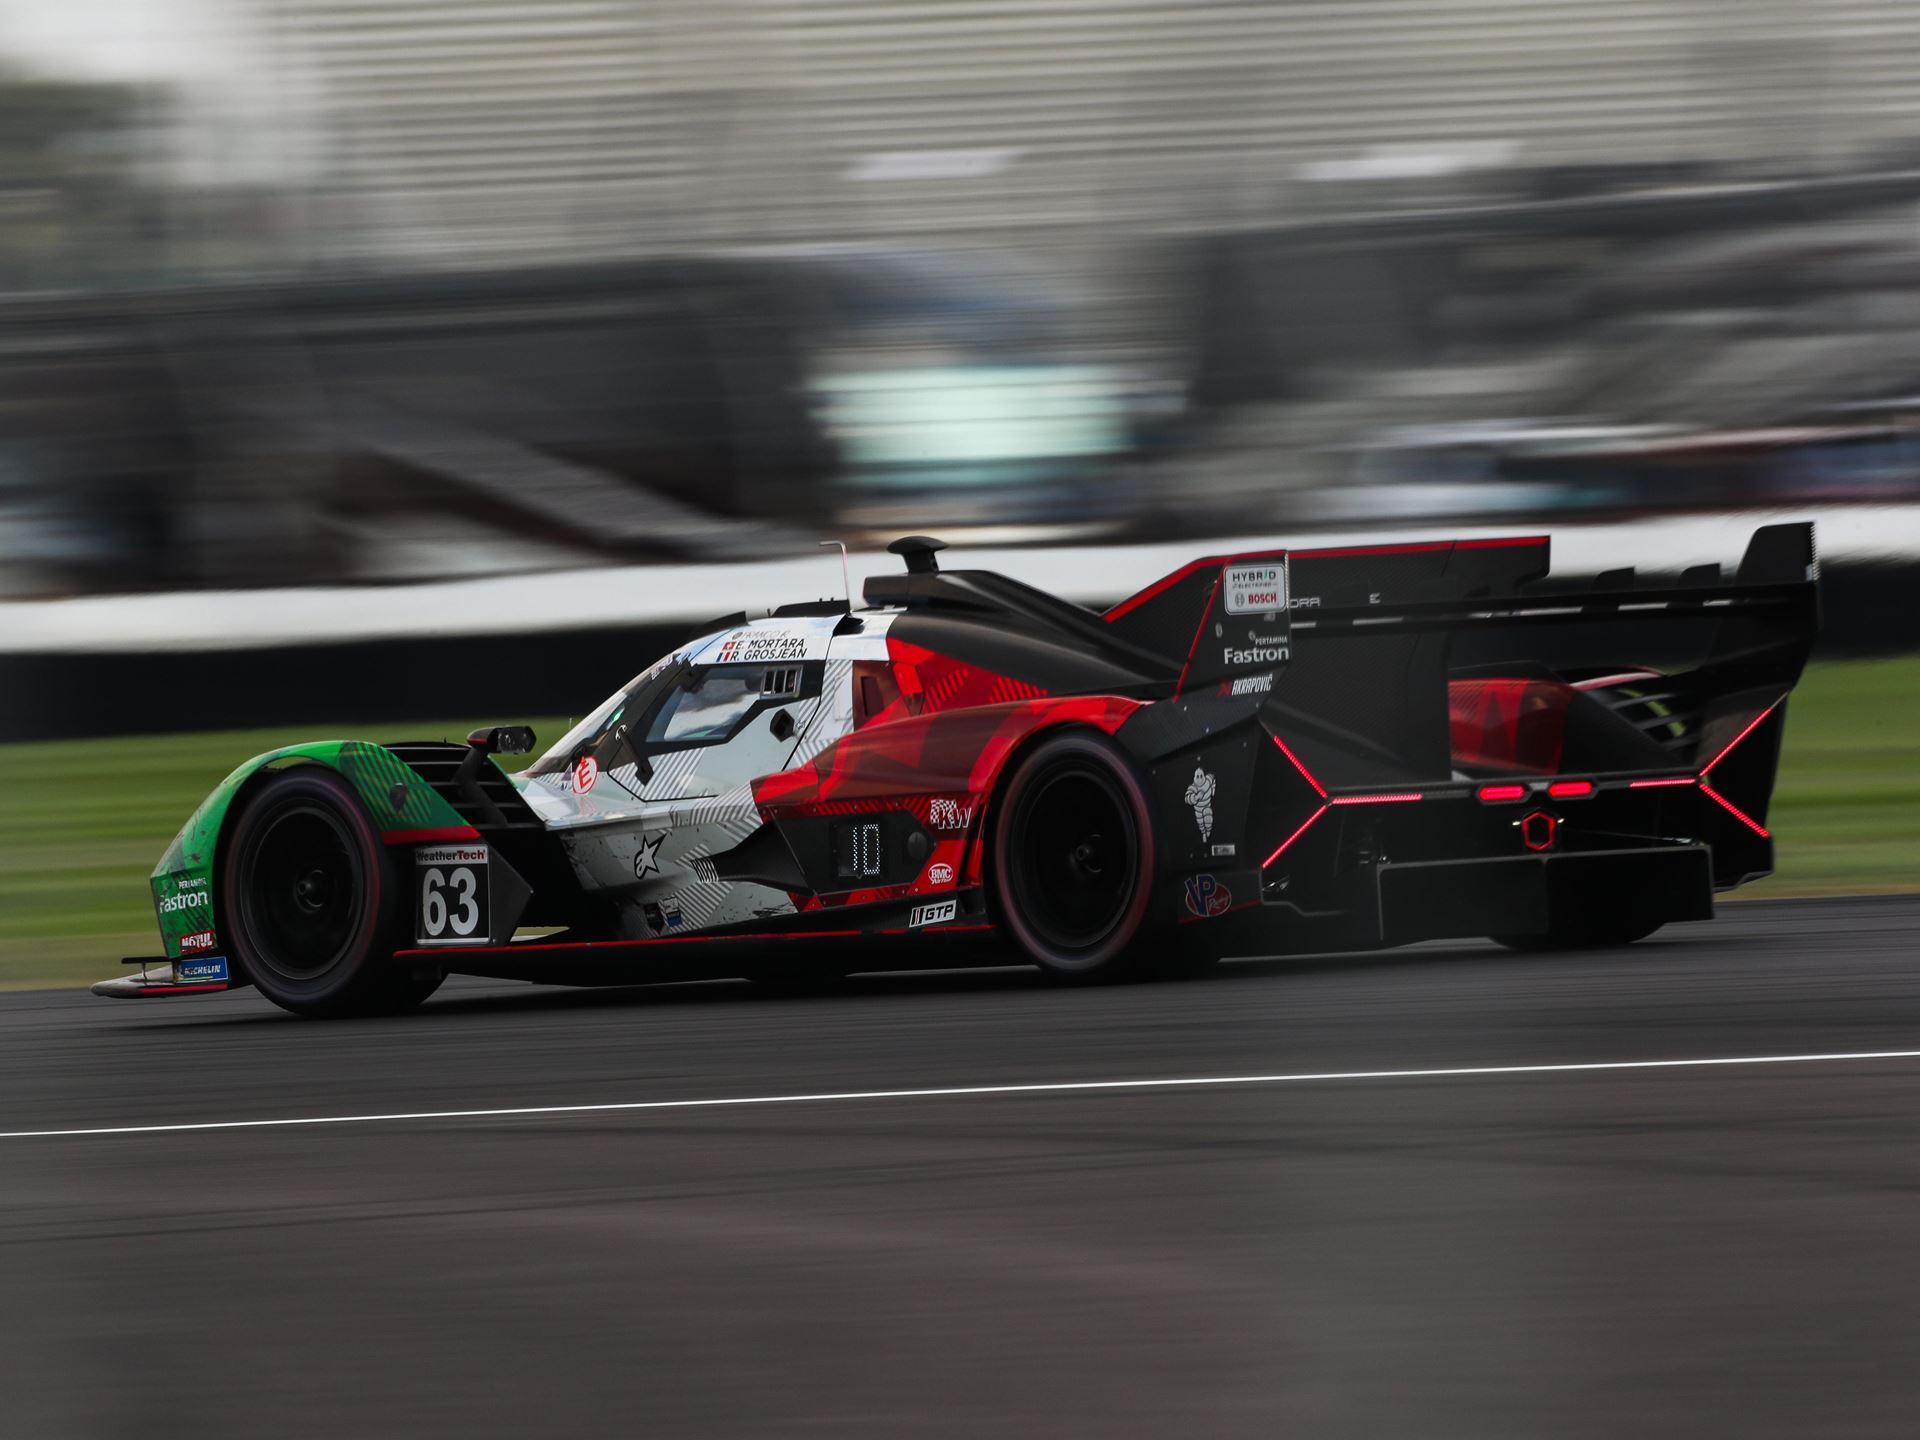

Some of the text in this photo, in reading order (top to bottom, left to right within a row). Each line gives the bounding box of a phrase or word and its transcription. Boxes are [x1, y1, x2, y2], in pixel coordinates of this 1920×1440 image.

[1232, 569, 1276, 582] HYBRID
[1248, 592, 1277, 604] BOSCH
[735, 638, 805, 650] E. MORTARA
[1255, 635, 1288, 645] PERTAMINA
[730, 648, 807, 661] R. GROSJEAN
[1224, 647, 1289, 664] Fastron
[938, 807, 972, 829] KW
[416, 849, 485, 862] WeatherTech
[853, 824, 880, 875] 10
[931, 868, 951, 879] BMC
[423, 867, 479, 936] 63
[1184, 873, 1216, 917] VP
[925, 903, 953, 920] GTP
[181, 932, 213, 948] MOTUL
[184, 964, 221, 975] MICHELIN
